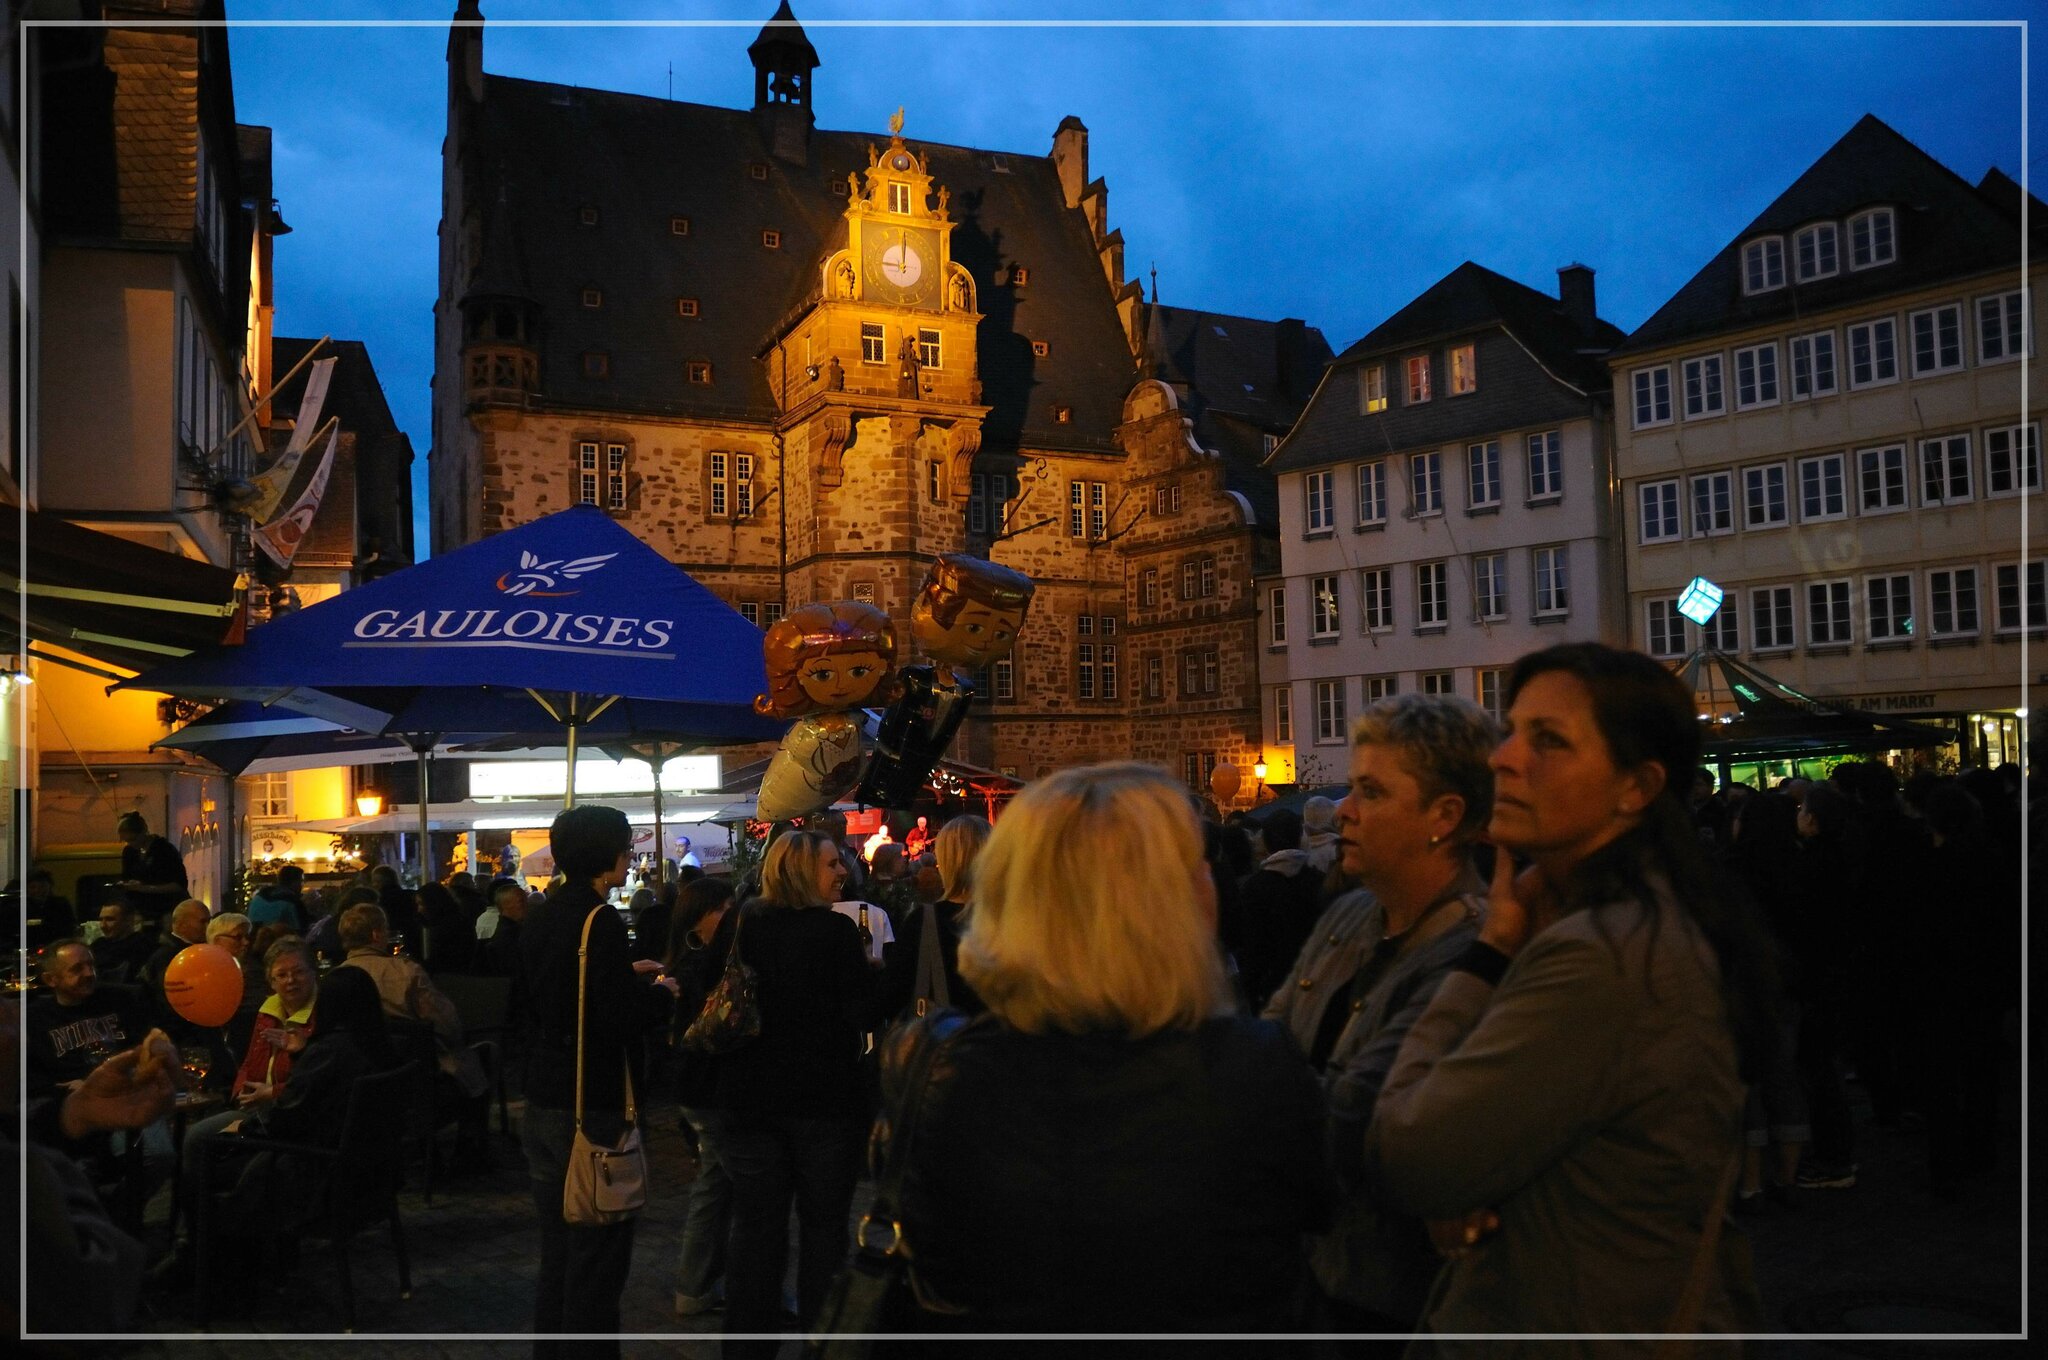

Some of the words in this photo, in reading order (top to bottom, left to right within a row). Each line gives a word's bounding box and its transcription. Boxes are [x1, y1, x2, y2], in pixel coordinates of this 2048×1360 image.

[353, 609, 674, 649] GAULOISES
[1860, 698, 1881, 711] AM
[1886, 694, 1937, 710] MARKT
[48, 1013, 126, 1058] NIKE
